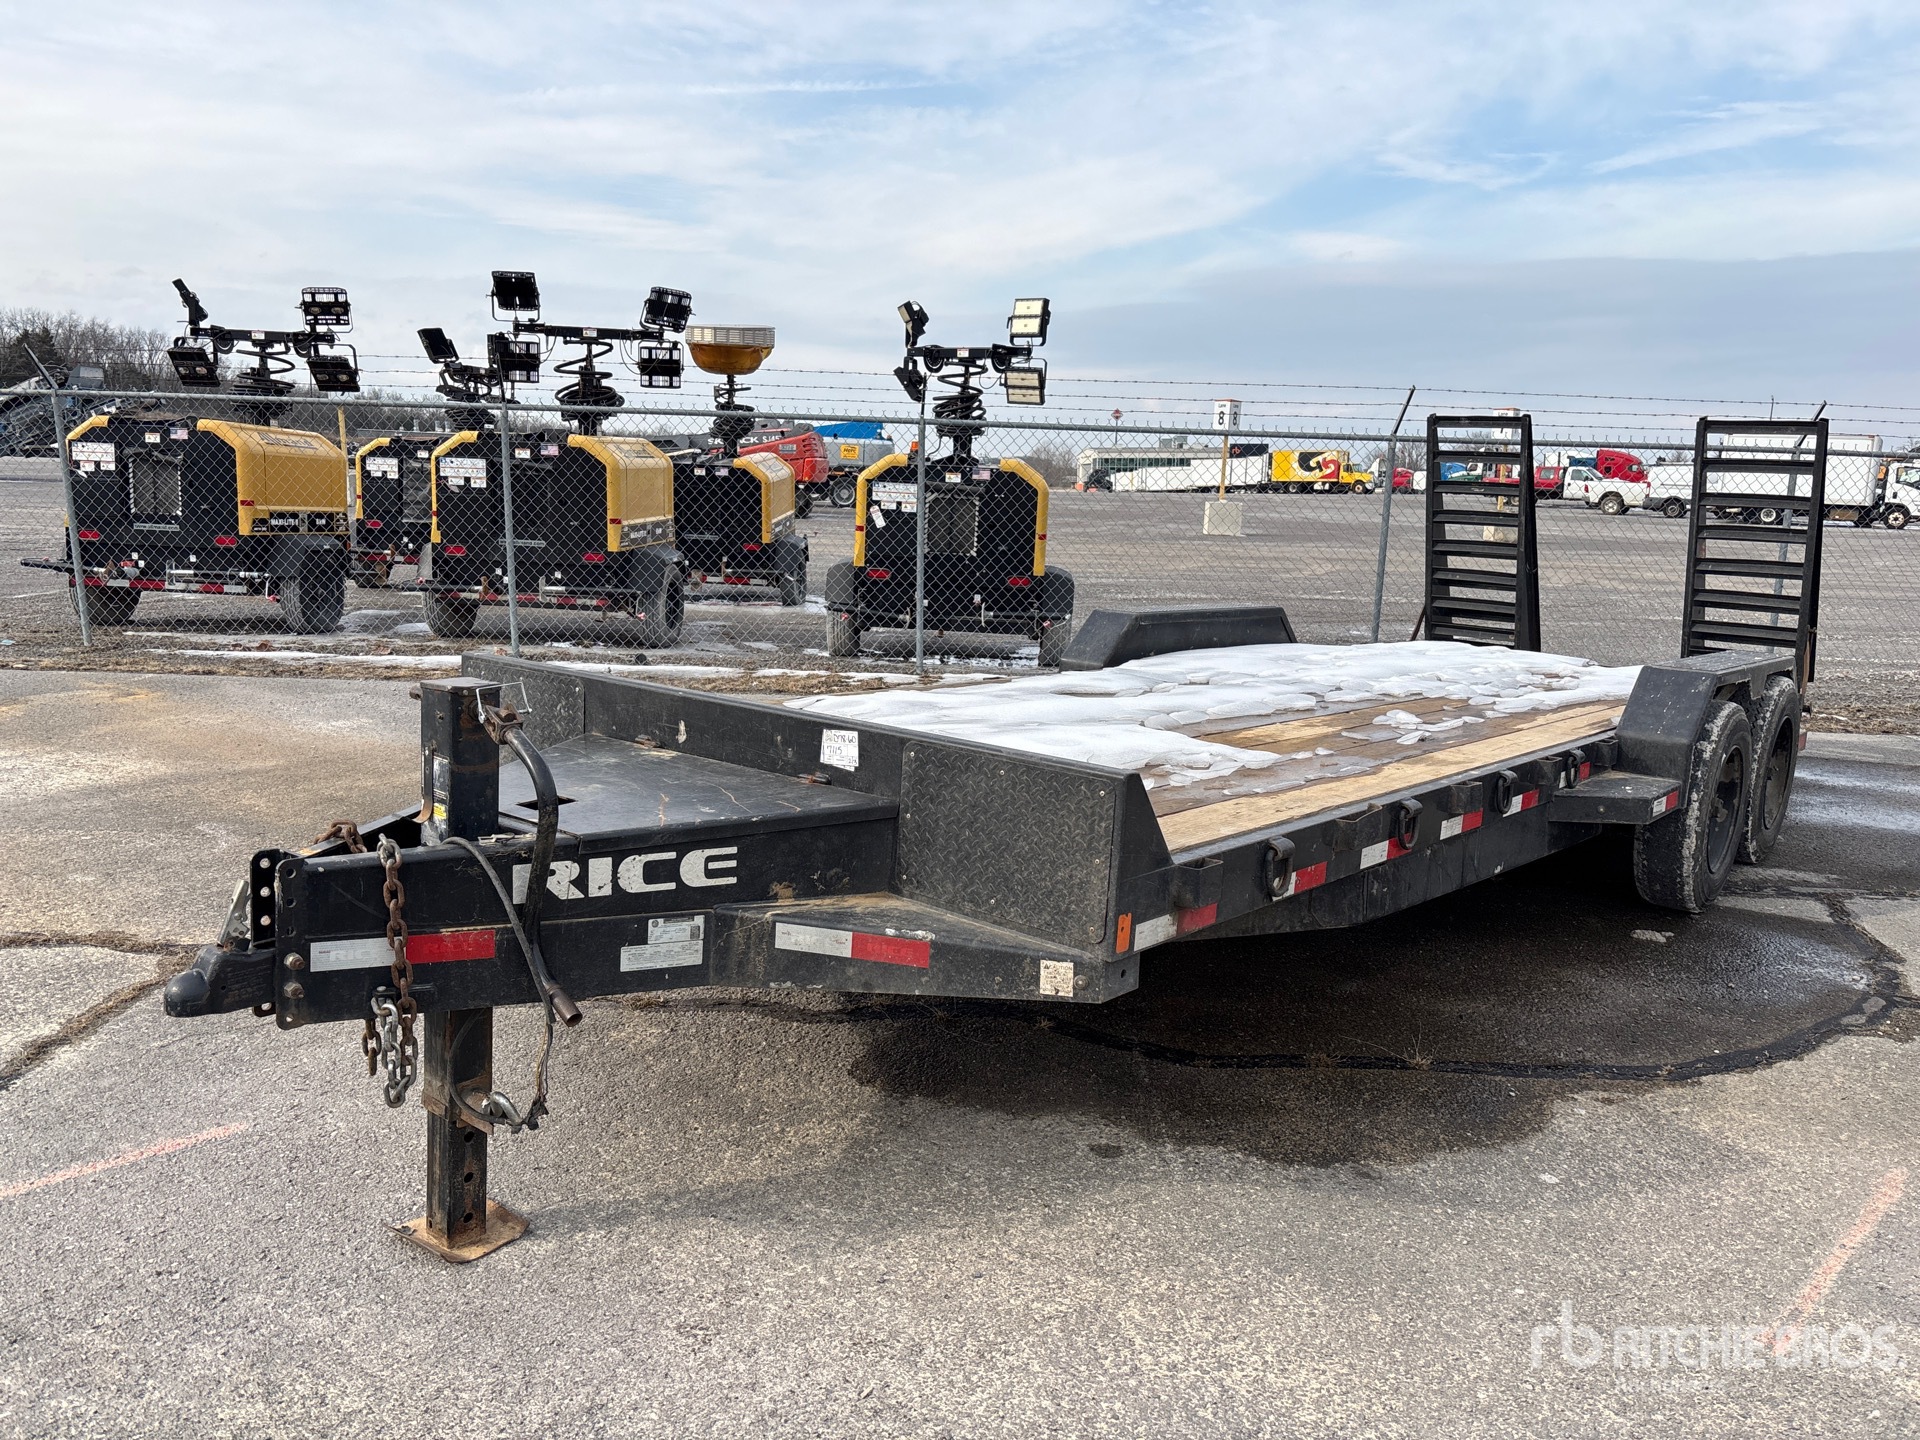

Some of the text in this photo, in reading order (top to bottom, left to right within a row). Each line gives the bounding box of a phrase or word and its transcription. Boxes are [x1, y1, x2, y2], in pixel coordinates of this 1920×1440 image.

[1218, 411, 1224, 425] 8
[1233, 411, 1237, 426] 8
[513, 847, 738, 905] RICE
